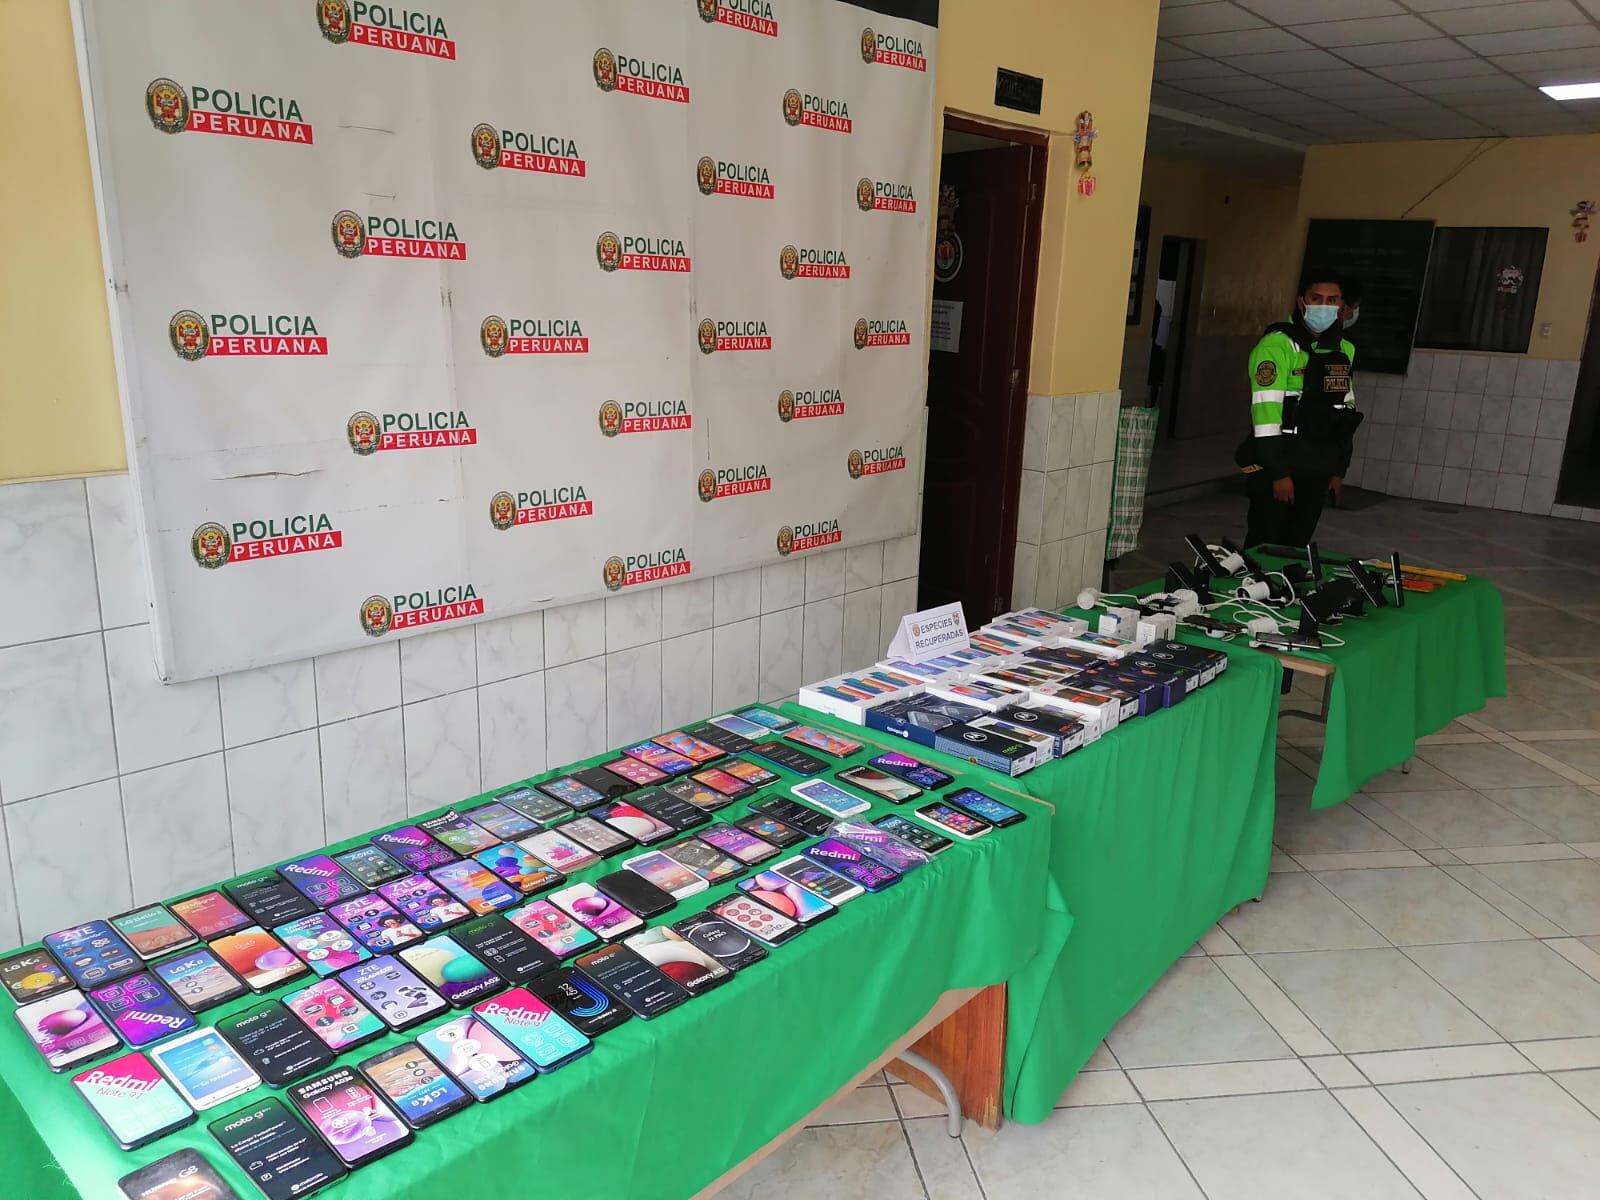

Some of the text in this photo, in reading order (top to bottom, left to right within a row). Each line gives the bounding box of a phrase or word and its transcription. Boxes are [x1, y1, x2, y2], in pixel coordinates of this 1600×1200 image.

[354, 1, 448, 39] POLICIA
[718, 9, 774, 34] PERUANA
[354, 25, 449, 57] PERUANA
[877, 34, 923, 57] POLICIA
[876, 51, 923, 69] PERUANA
[618, 56, 684, 85] POLICIA
[619, 76, 685, 101] PERUANA
[192, 86, 303, 122] POLICIA
[805, 94, 848, 118] POLICIA
[193, 111, 306, 141] PERUANA
[803, 113, 848, 131] PERUANA
[502, 130, 579, 158] POLICIA
[503, 151, 580, 174] PERUANA
[718, 161, 769, 184] POLICIA
[716, 180, 770, 197] PERUANA
[876, 182, 913, 200] POLICIA
[875, 199, 913, 210] PERUANA
[368, 216, 459, 241] POLICIA
[368, 239, 460, 258] PERUANA
[624, 237, 685, 256] POLICIA
[623, 256, 686, 270] PERUANA
[800, 249, 846, 265] POLICIA
[799, 266, 846, 277] PERUANA
[211, 314, 318, 335] POLICIA
[511, 320, 582, 337] POLICIA
[718, 321, 767, 336] POLICIA
[869, 320, 907, 332] POLICIA
[212, 338, 321, 353] PERUANA
[510, 339, 583, 352] PERUANA
[716, 338, 768, 349] PERUANA
[868, 335, 907, 344] PERUANA
[796, 389, 841, 405] POLICIA
[625, 400, 687, 418] POLICIA
[795, 404, 841, 417] PERUANA
[383, 411, 469, 432] POLICIA
[624, 417, 687, 431] PERUANA
[383, 431, 471, 448] PERUANA
[864, 446, 905, 463] POLICIA
[718, 465, 768, 485] POLICIA
[864, 460, 905, 474] PERUANA
[518, 486, 587, 508] POLICIA
[717, 480, 767, 498] PERUANA
[518, 503, 588, 523] PERUANA
[232, 514, 333, 543] POLICIA
[795, 519, 838, 539] POLICIA
[234, 533, 335, 559] PERUANA
[794, 534, 838, 550] PERUANA
[627, 548, 686, 571] POLICIA
[627, 564, 686, 584] PERUANA
[394, 584, 477, 612] POLICIA
[394, 602, 478, 628] PERUANA
[920, 617, 953, 634] ESPECIES
[915, 629, 964, 649] RECUPERADAS
[877, 757, 918, 769] Redmi
[379, 833, 427, 847] Redmi
[809, 847, 857, 862] Redmi
[284, 864, 336, 878] Redmi
[391, 877, 418, 892] ZTE
[343, 897, 370, 913] ZTE
[62, 926, 95, 942] ZTE
[357, 963, 380, 976] ZTE
[686, 972, 714, 987] Galaxy
[451, 984, 484, 1000] Galaxy
[123, 1010, 186, 1029] Redmi
[237, 1015, 259, 1028] moto
[484, 1002, 548, 1023] Redmi
[504, 1016, 529, 1027] Note
[86, 1070, 157, 1091] Redmi
[298, 1069, 350, 1095] SAMSUNG
[97, 1086, 127, 1098] Note
[302, 1083, 334, 1100] Galaxy
[224, 1116, 254, 1132] moto
